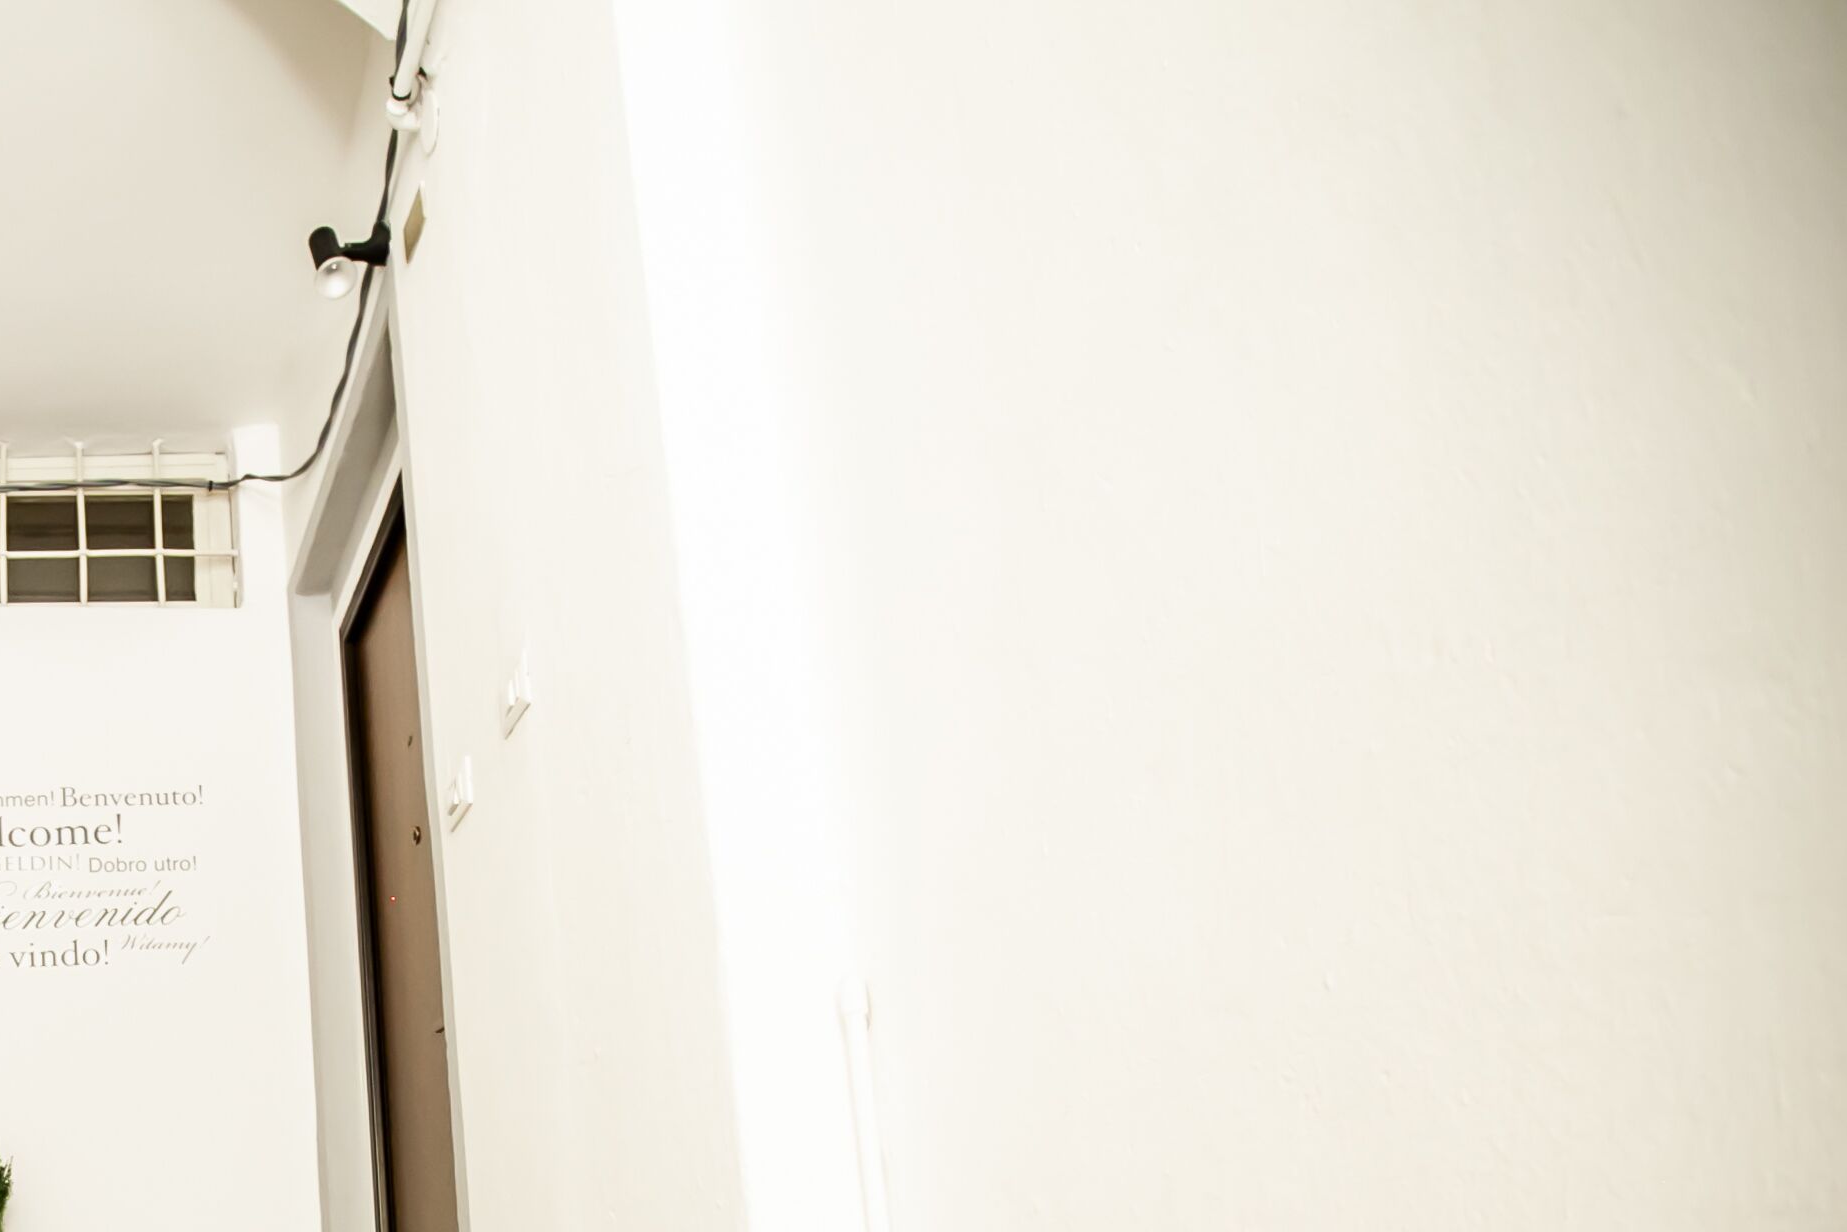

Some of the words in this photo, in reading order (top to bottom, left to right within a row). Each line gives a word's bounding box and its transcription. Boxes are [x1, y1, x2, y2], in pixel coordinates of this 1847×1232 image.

[60, 785, 204, 808] Benvenuto!
[89, 857, 147, 873] Dobro
[154, 856, 198, 872] utro!
[9, 939, 110, 968] vindo!
